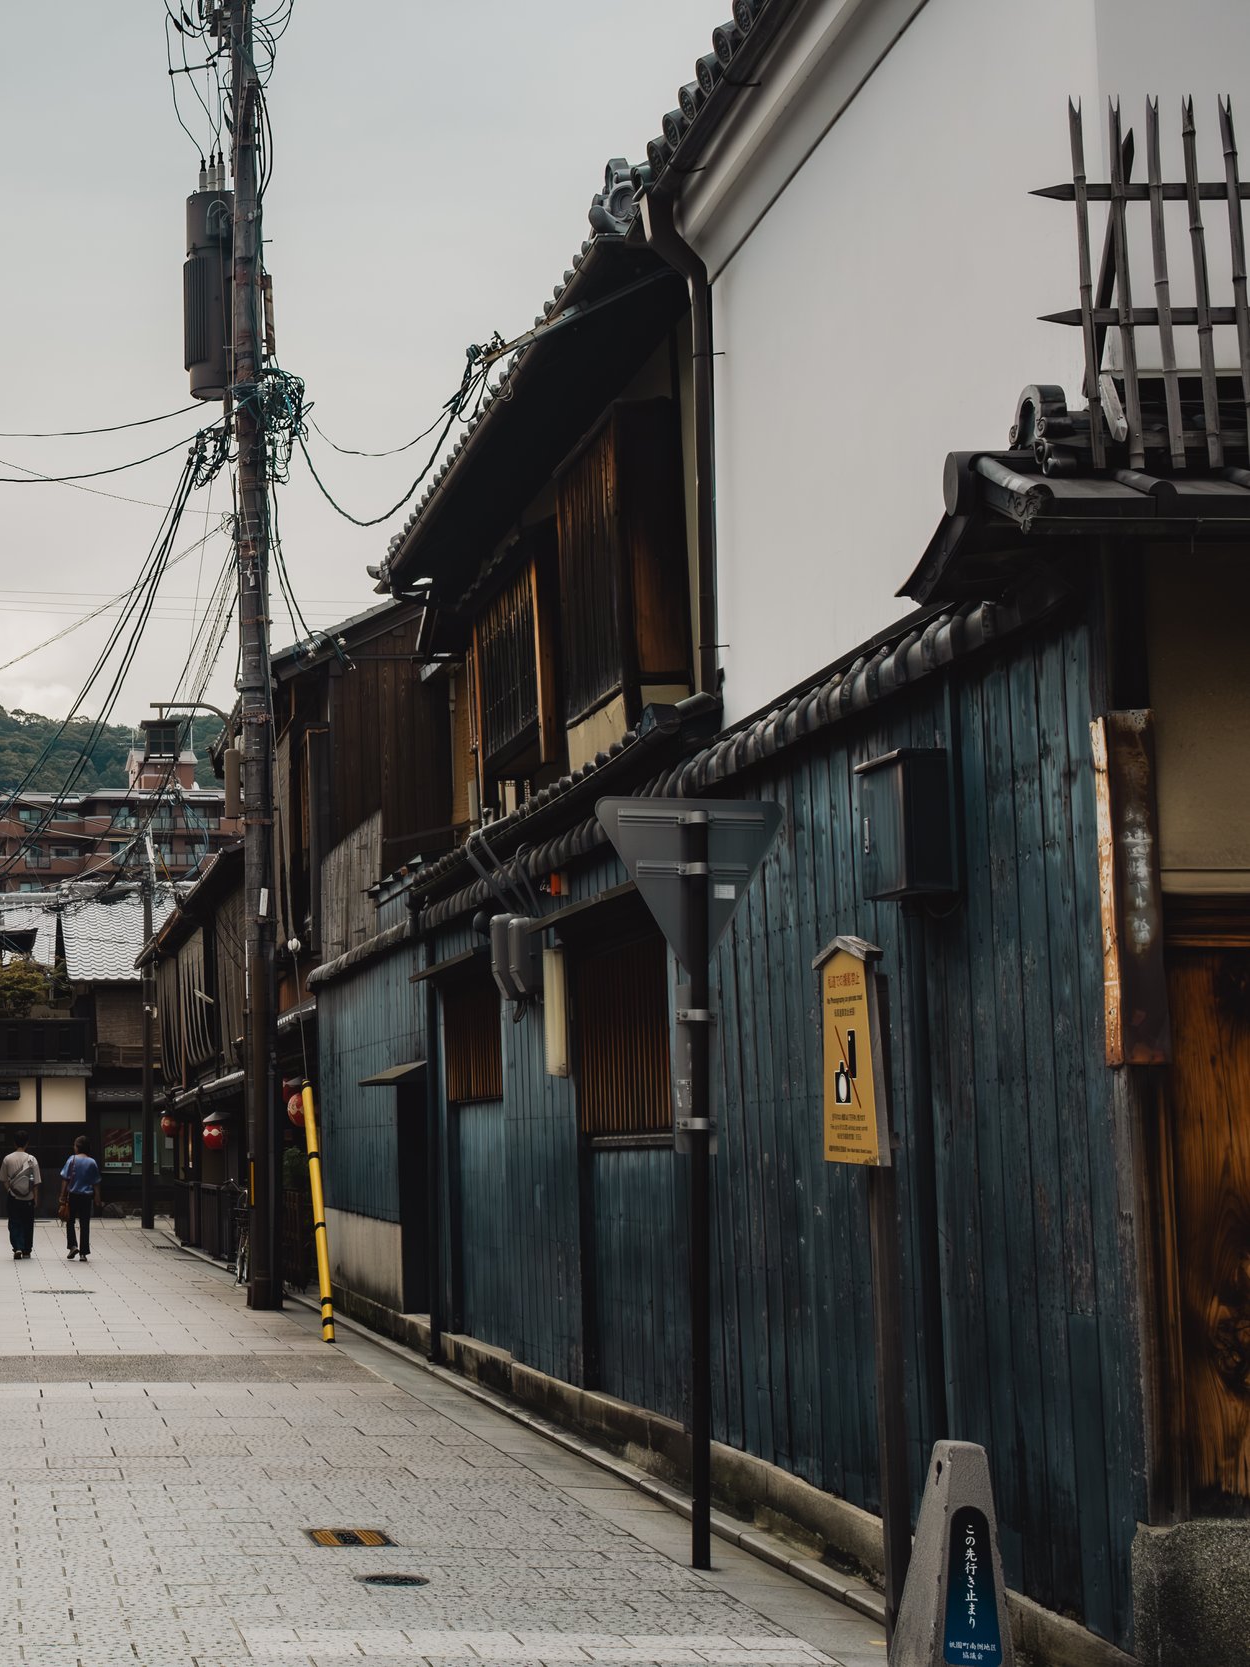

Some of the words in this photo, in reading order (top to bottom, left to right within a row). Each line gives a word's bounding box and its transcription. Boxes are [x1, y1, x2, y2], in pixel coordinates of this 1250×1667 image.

[964, 1524, 978, 1630] この先行き止まり
